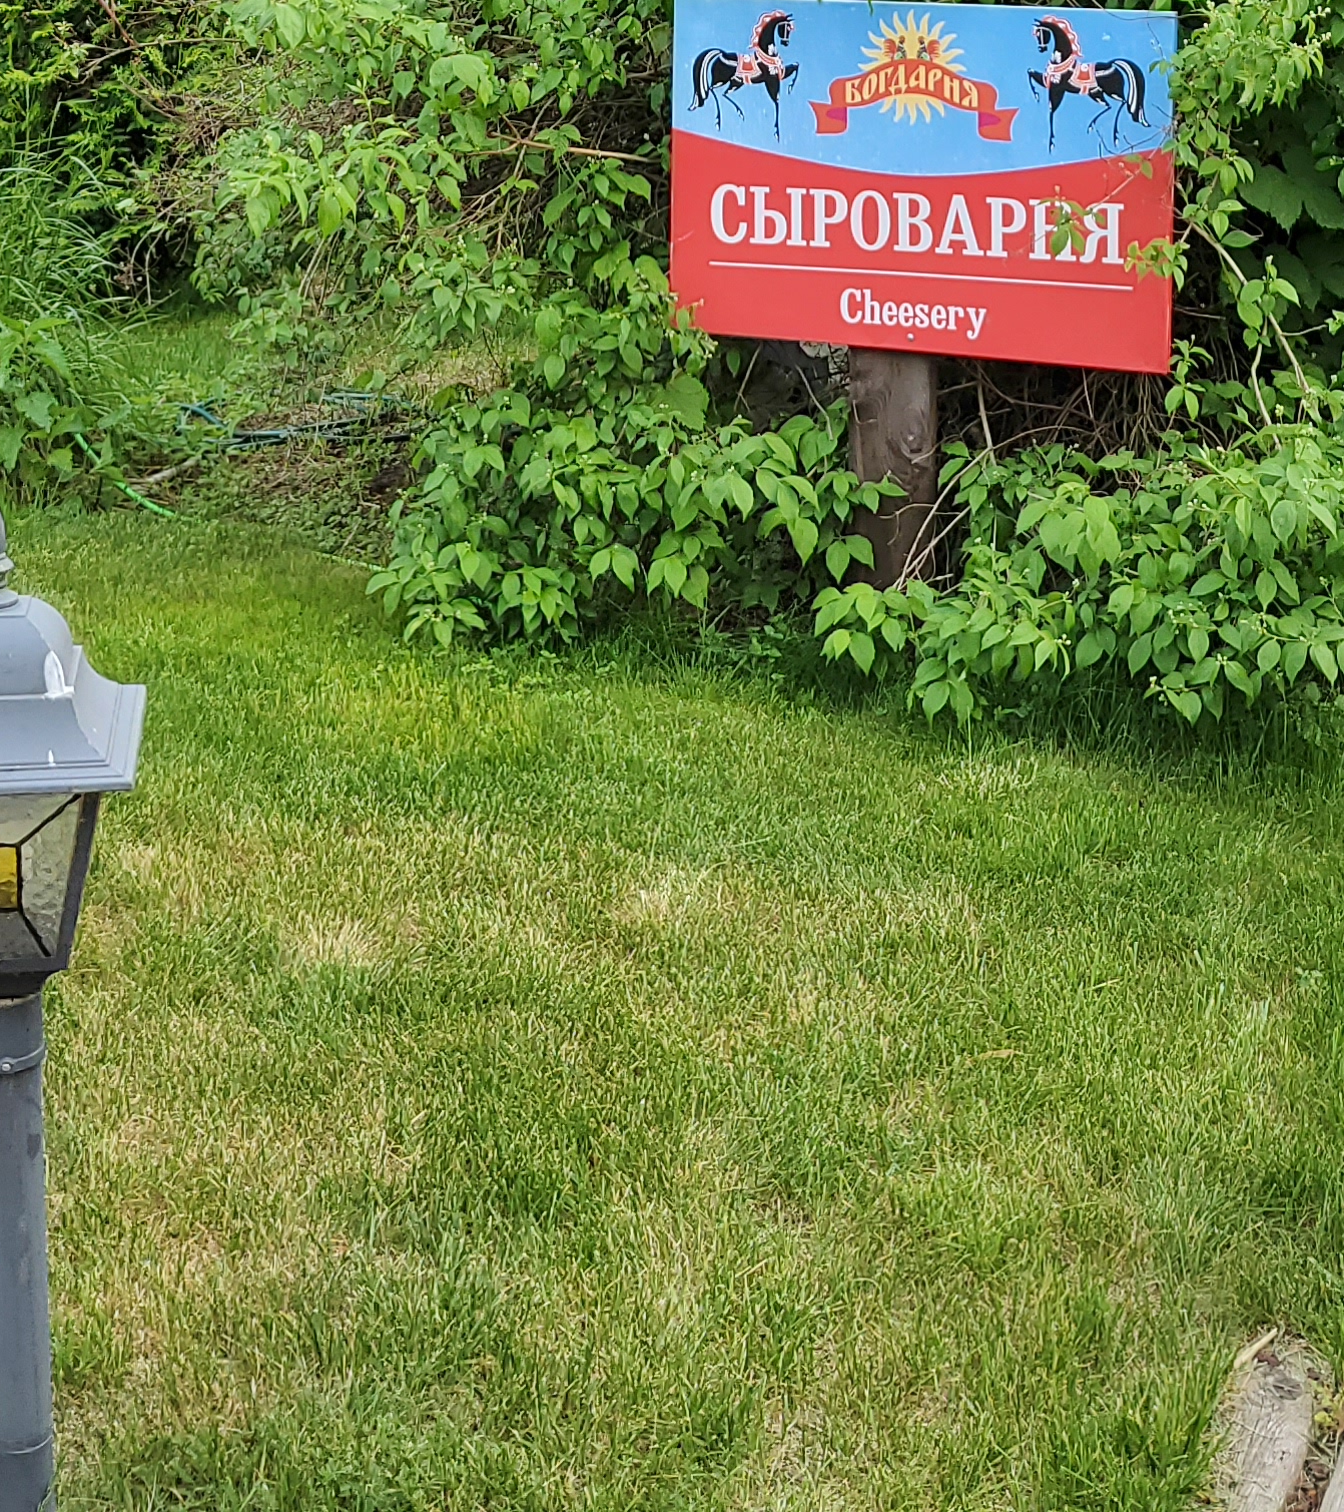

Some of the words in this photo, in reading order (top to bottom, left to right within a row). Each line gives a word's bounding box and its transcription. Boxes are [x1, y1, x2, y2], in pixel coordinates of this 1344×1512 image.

[845, 63, 979, 107] БОГДАРНЯ
[710, 183, 1124, 264] СЫРОВАРНЯ
[840, 288, 987, 339] Cheesery
